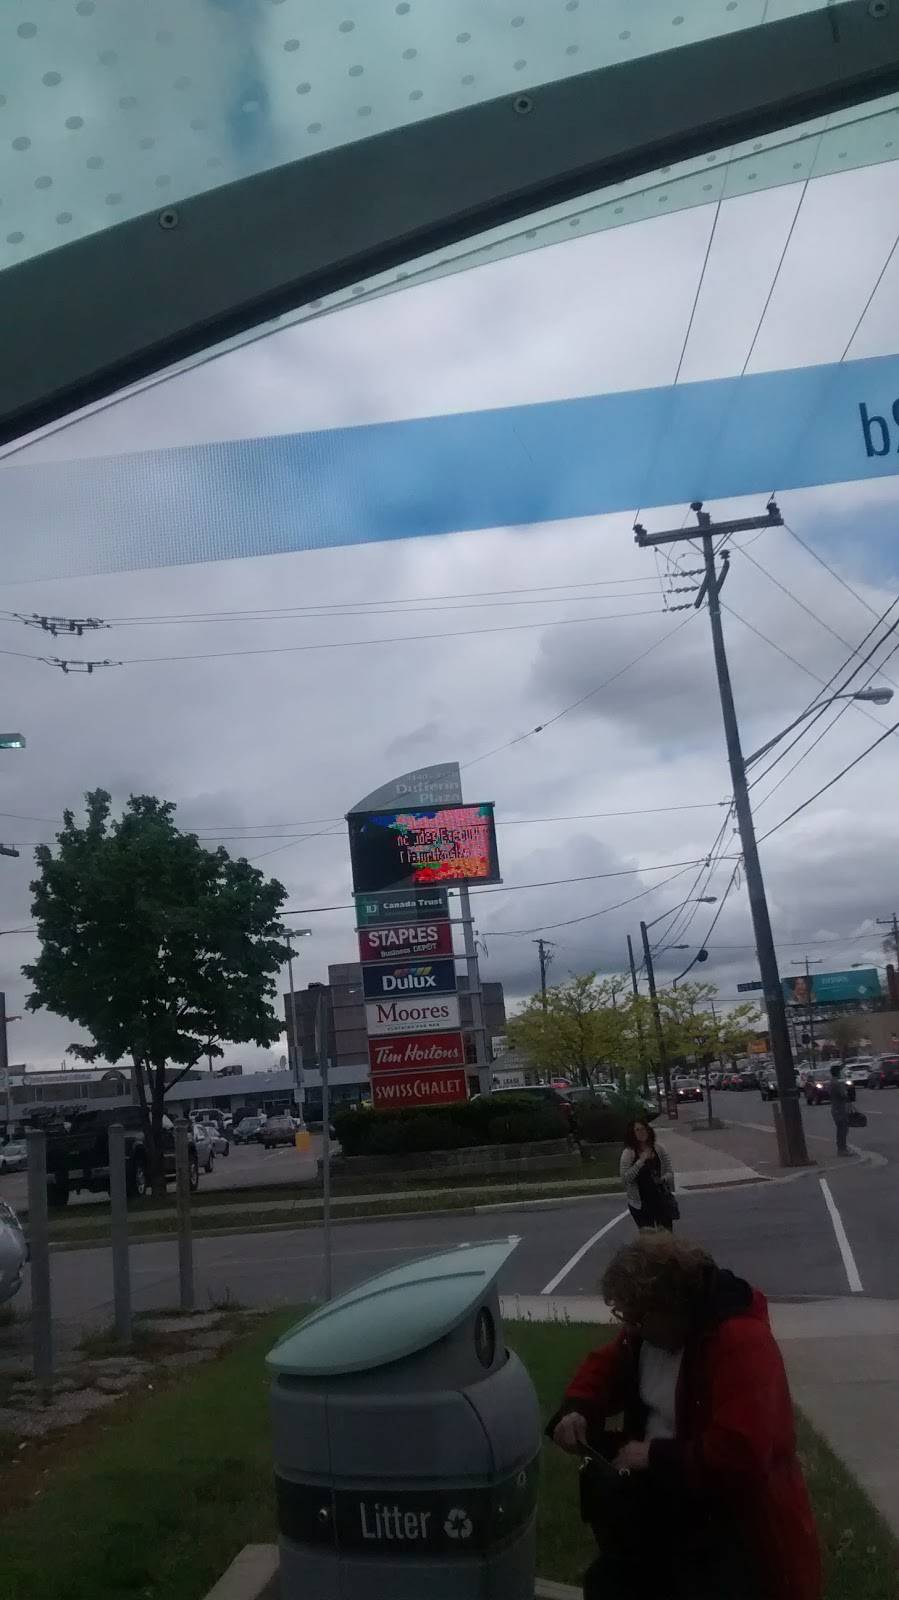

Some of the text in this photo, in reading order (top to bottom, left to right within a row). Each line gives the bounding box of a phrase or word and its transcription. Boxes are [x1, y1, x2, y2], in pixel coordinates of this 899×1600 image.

[419, 792, 460, 804] Plaza
[383, 900, 416, 909] Canada
[417, 898, 443, 907] Trust
[368, 926, 438, 947] STAPLES
[412, 943, 437, 953] DEPOT
[382, 974, 437, 991] Dulux
[376, 1003, 449, 1023] Moores
[375, 1043, 459, 1064] Tim Hortons
[360, 1502, 431, 1539] Litter
